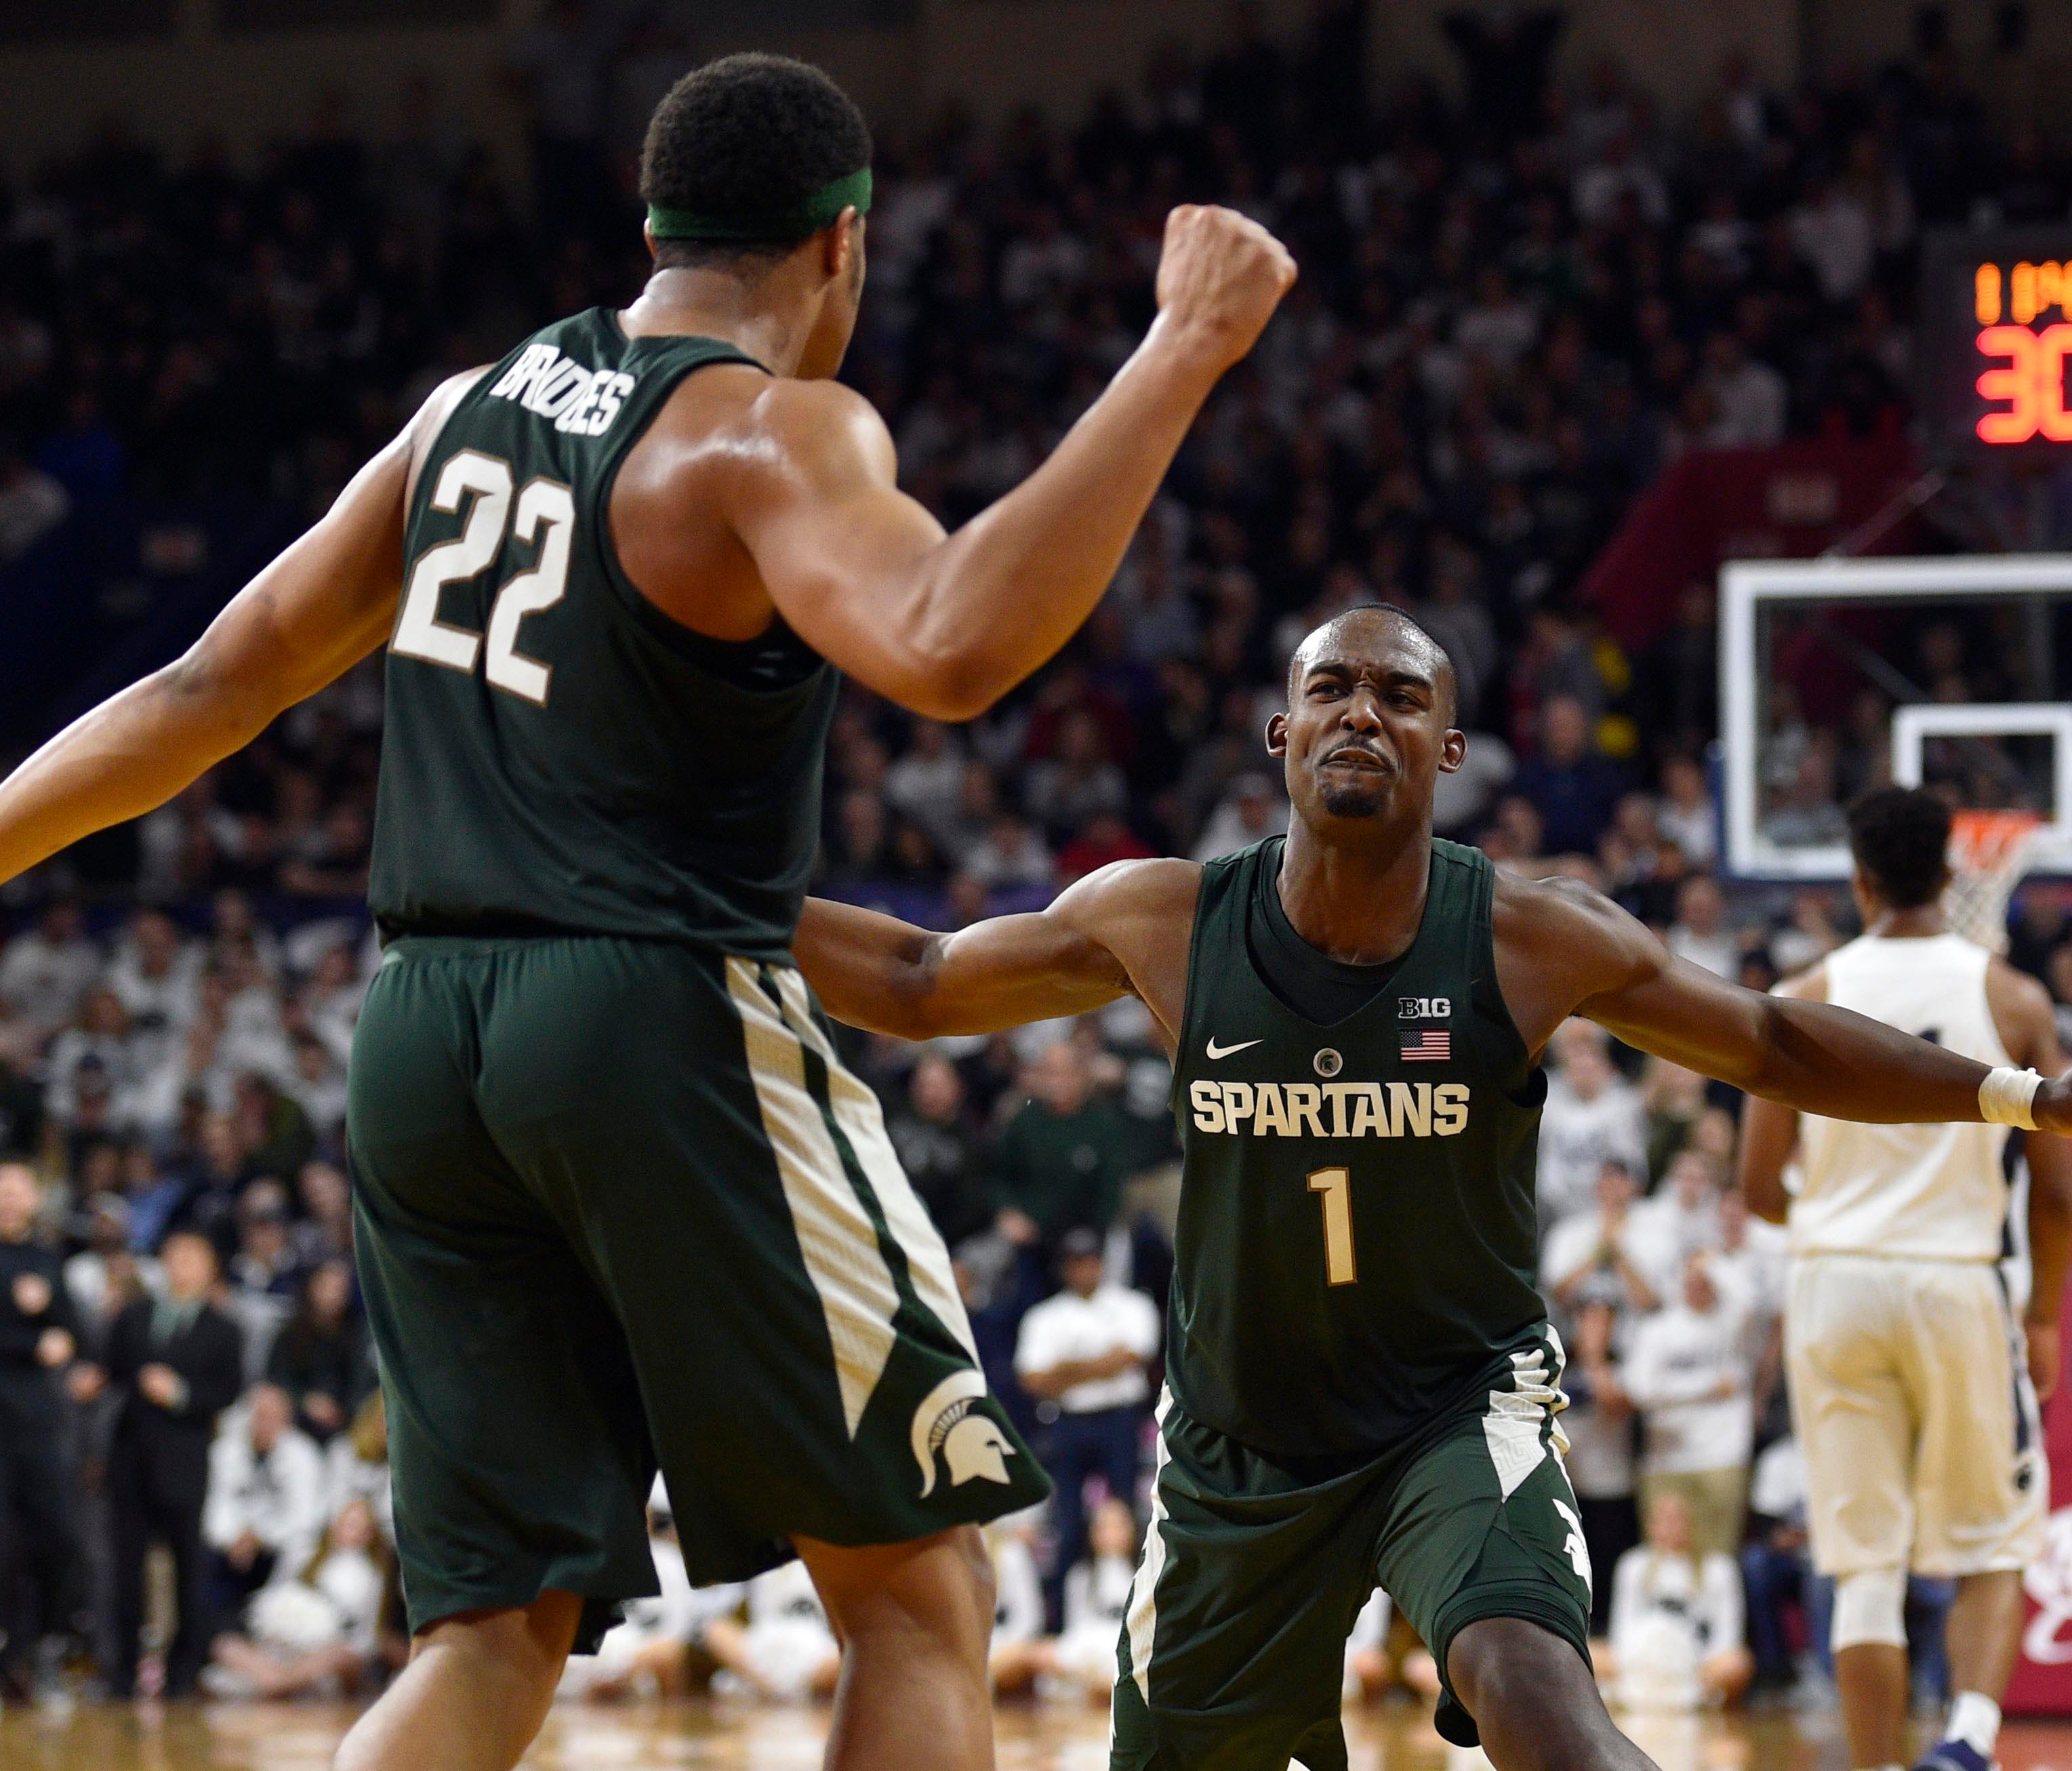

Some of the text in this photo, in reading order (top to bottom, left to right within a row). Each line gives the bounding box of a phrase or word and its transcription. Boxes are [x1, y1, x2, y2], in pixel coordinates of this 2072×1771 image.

[389, 448, 575, 708] 22
[1190, 1080, 1470, 1137] SPARTANS
[1306, 1166, 1358, 1287] 1
